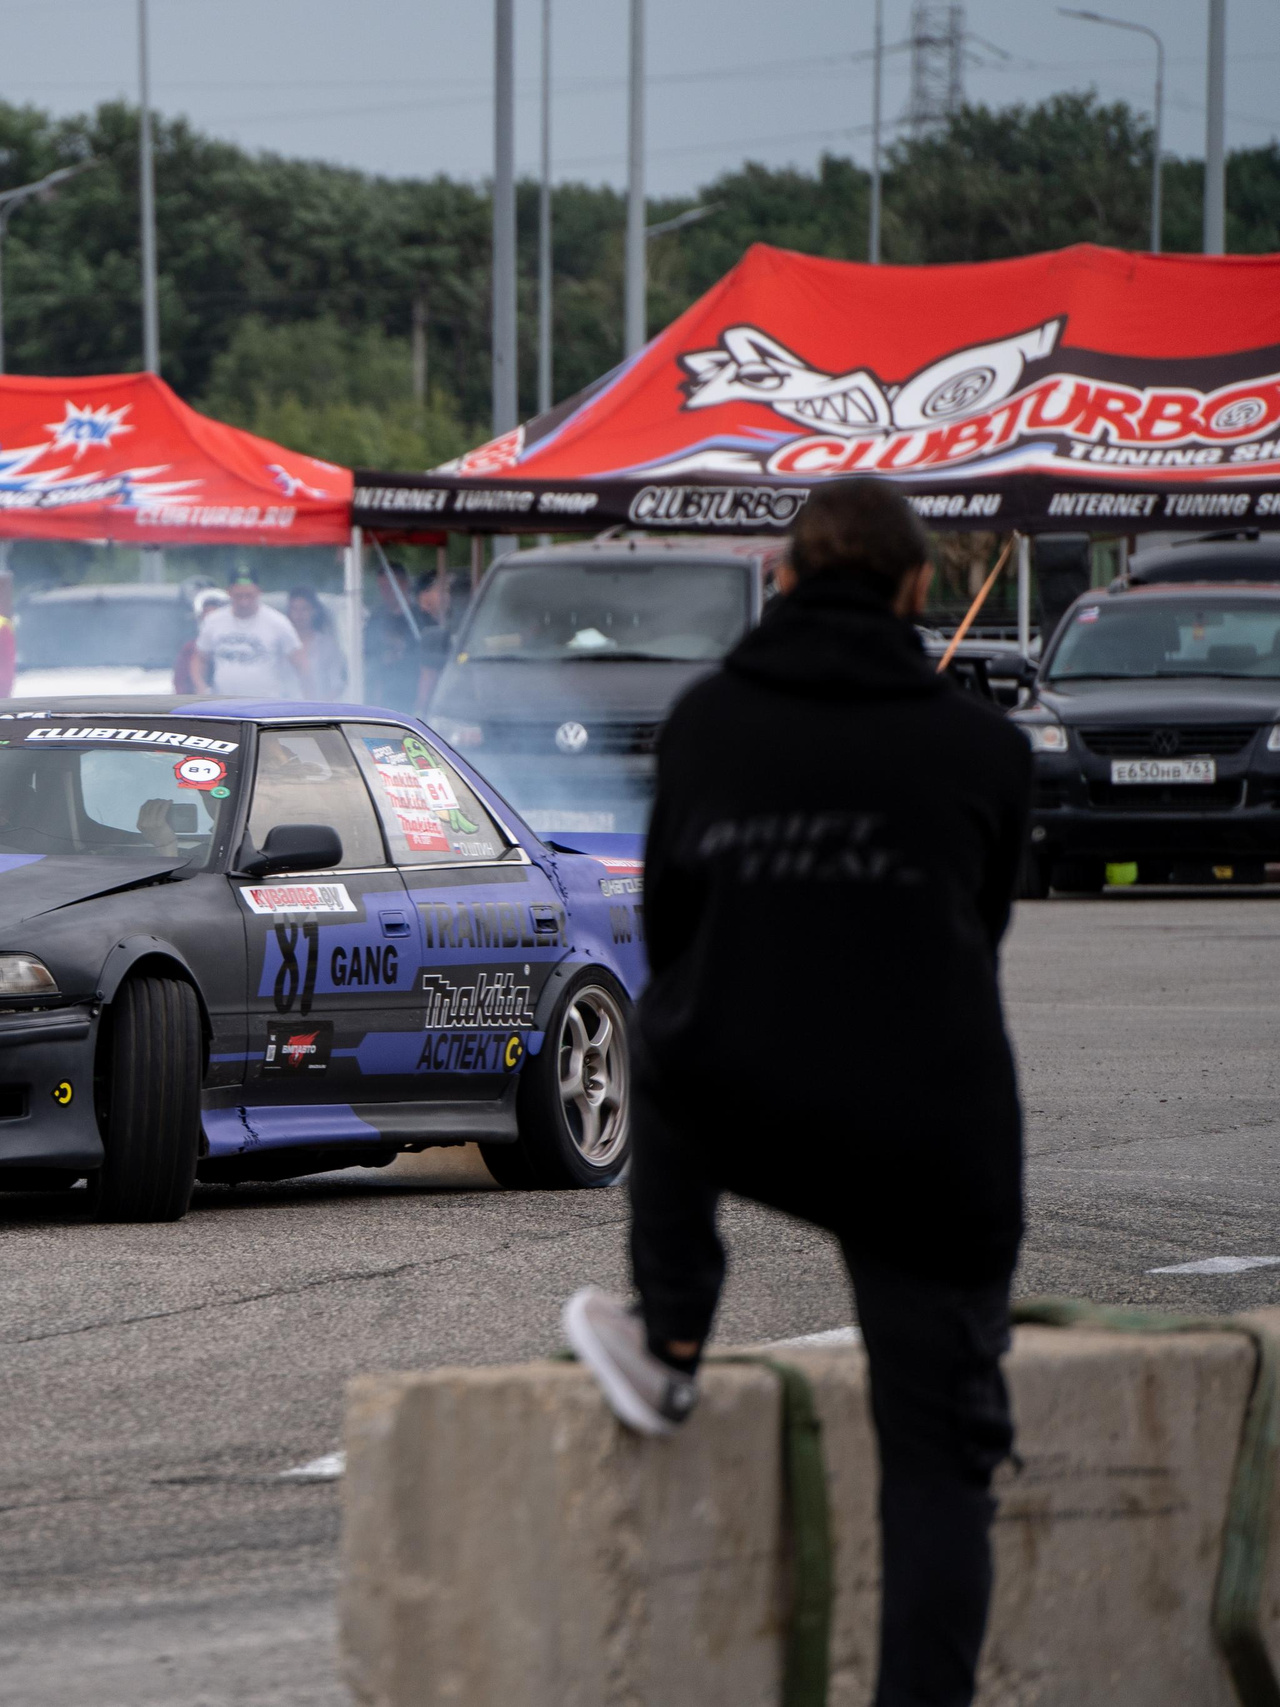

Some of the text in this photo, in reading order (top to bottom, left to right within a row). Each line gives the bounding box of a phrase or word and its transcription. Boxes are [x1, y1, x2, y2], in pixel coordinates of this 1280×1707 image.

[772, 376, 1280, 474] CLUBTURBO
[1070, 441, 1224, 467] TUNING
[538, 491, 599, 515] SHOP
[626, 486, 810, 525] CLUBTURBO
[1048, 493, 1158, 517] INTERNET
[1164, 493, 1251, 516] TUNING
[135, 505, 297, 529] CLUBTURBO.RU
[26, 727, 240, 754] CLUBTURBO
[188, 766, 211, 774] 81
[426, 783, 449, 801] 81
[416, 902, 569, 949] TRAMBLER
[273, 912, 319, 1017] 81
[330, 945, 399, 987] GANG
[416, 1032, 508, 1071] АСПЕКТ
